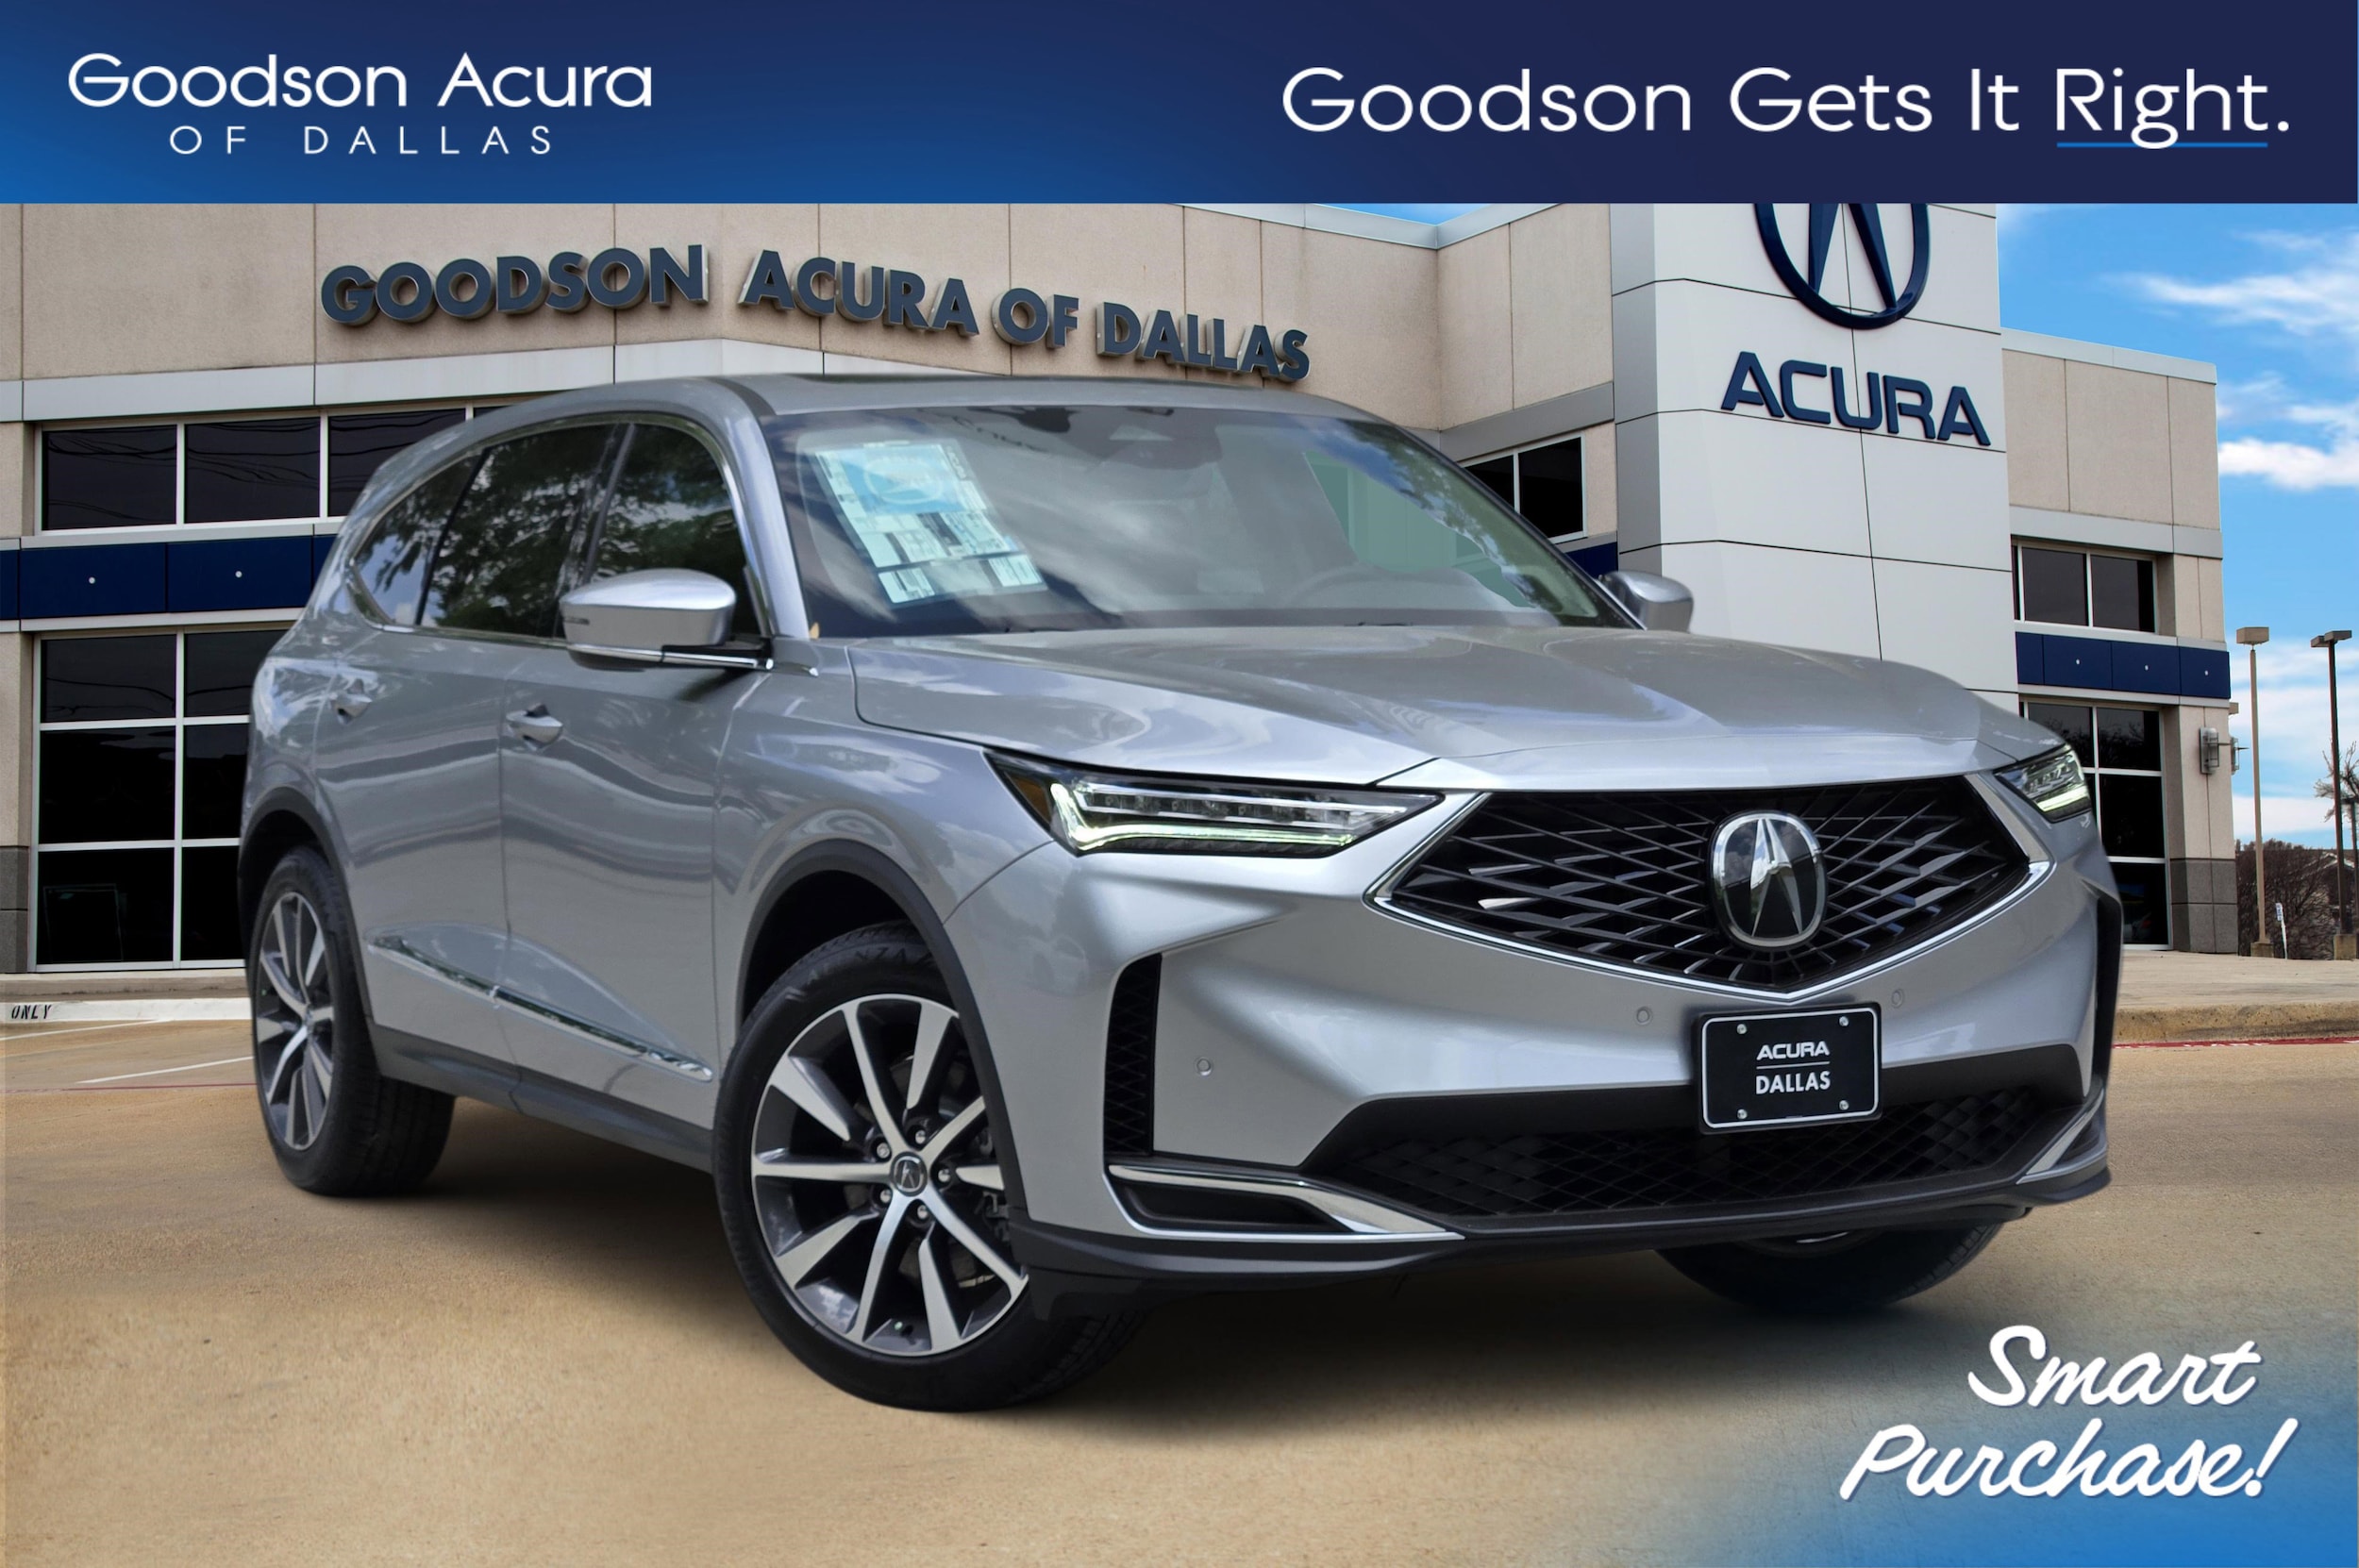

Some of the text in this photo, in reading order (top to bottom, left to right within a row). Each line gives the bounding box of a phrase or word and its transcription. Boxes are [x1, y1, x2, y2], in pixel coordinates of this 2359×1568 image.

[321, 243, 1311, 381] GOODSON ACURA OF DALLAS
[1720, 350, 1991, 446] ACURA
[10, 1004, 52, 1020] ONLY
[1756, 1041, 1831, 1060] ACURA
[1755, 1070, 1832, 1095] DALLAS
